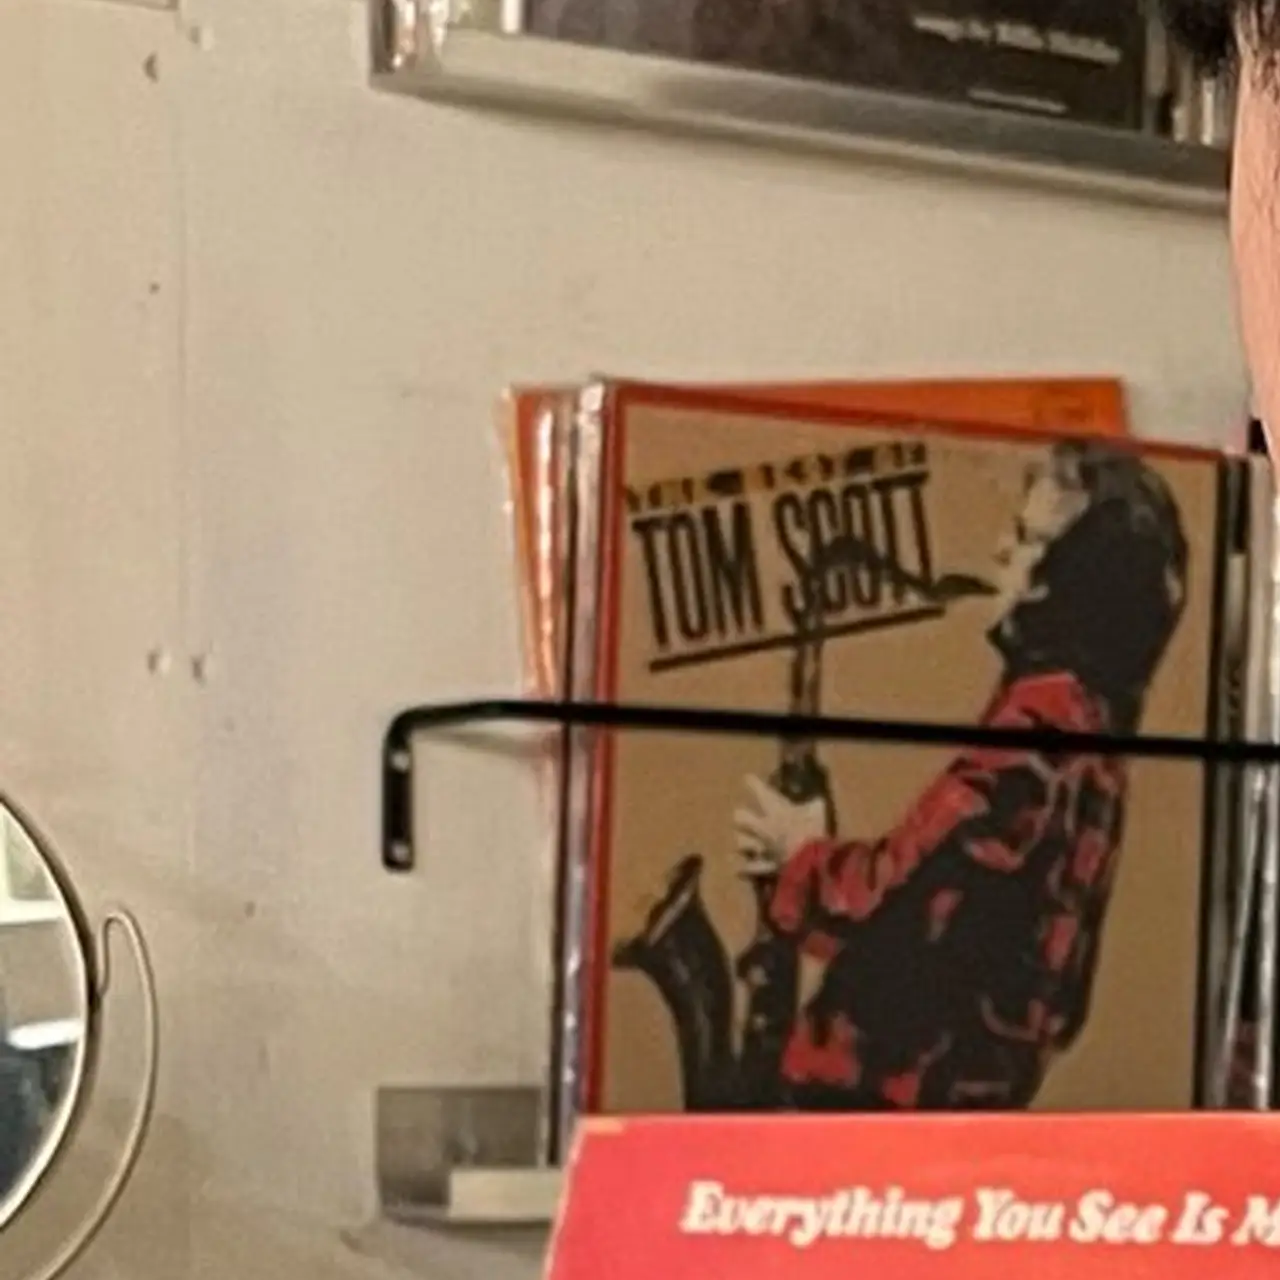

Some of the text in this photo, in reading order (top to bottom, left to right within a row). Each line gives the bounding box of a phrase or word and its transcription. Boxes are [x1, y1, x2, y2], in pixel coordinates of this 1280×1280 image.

[632, 500, 765, 652] TOM
[773, 470, 934, 622] SCOTT
[680, 1180, 964, 1250] Everything
[973, 1186, 1066, 1243] You
[1068, 1189, 1168, 1245] See
[1171, 1191, 1230, 1245] Is
